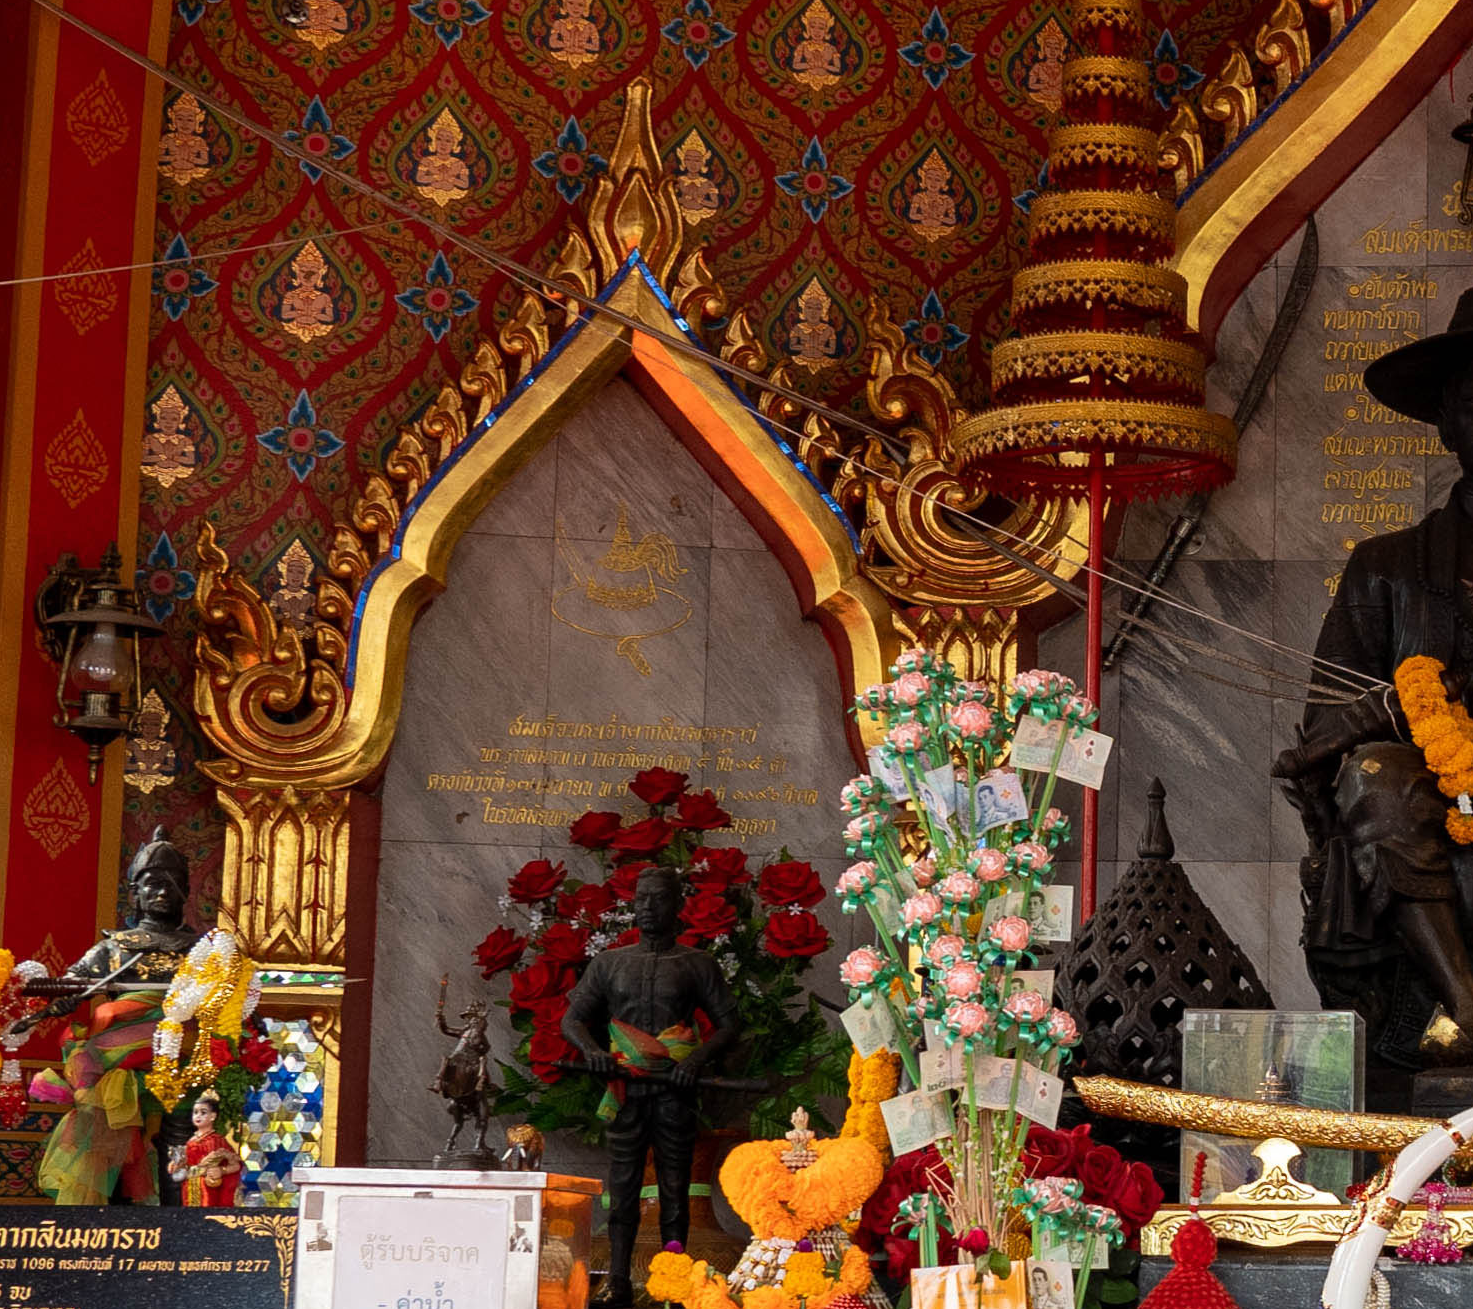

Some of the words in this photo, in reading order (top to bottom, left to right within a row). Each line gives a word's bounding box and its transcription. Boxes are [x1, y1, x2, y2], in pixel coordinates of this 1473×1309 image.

[359, 1234, 480, 1270] ตู้รับบริจาค
[22, 1258, 54, 1270] 1096
[118, 1259, 134, 1271] 17
[236, 1260, 270, 1273] 2277
[9, 1285, 31, 1301] จบ
